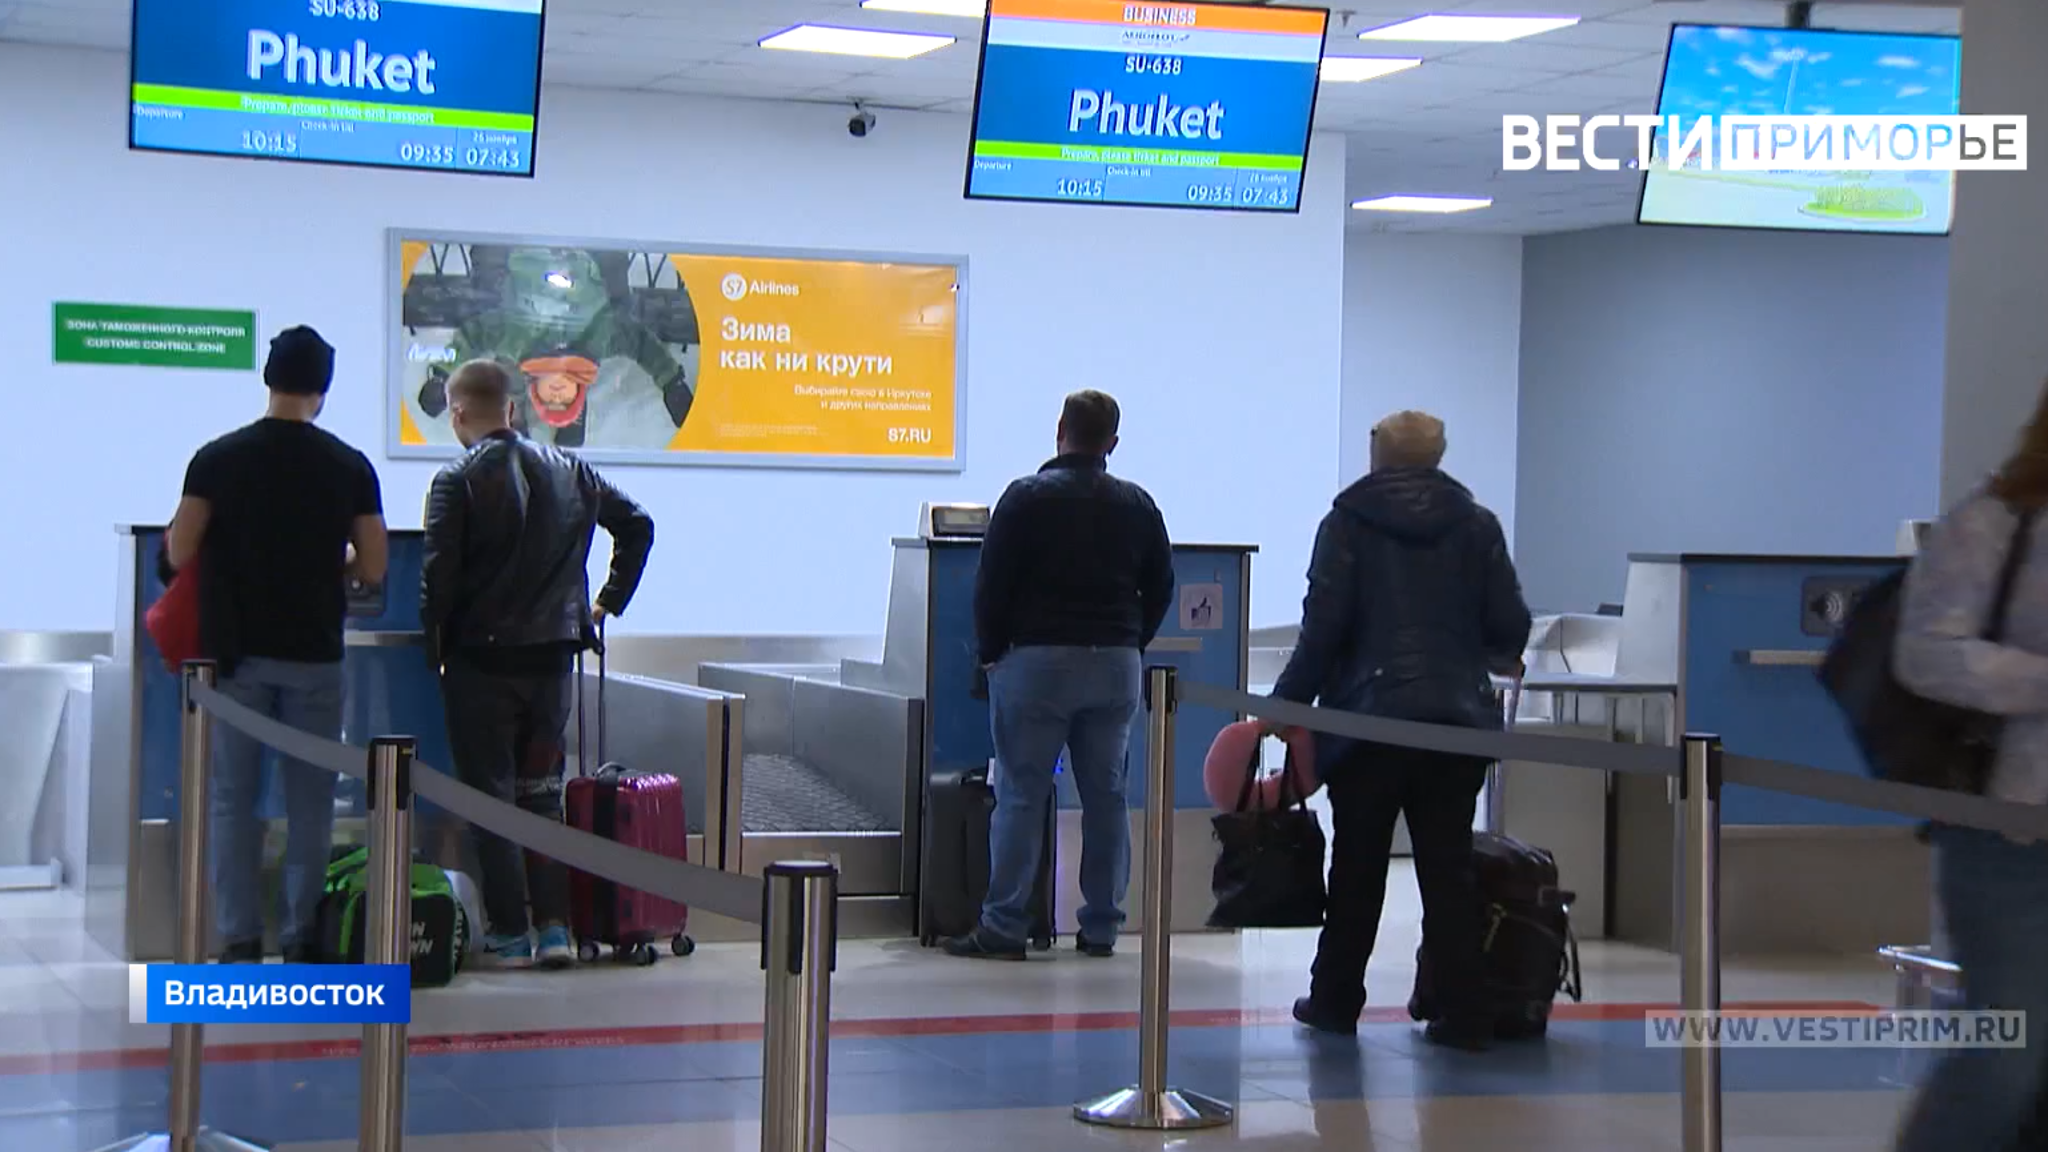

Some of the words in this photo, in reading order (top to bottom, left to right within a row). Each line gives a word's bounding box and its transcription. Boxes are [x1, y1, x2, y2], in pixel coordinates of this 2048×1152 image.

[309, 0, 381, 21] SU-638
[1123, 6, 1197, 26] BUSINESS
[247, 29, 436, 95] Phuket
[1125, 55, 1182, 76] SU-638
[136, 105, 184, 120] Departure
[387, 110, 434, 126] passport
[1068, 88, 1225, 140] Phuket
[242, 130, 297, 153] 10:15
[400, 142, 454, 164] 09:35
[466, 147, 520, 168] 07:43
[1161, 150, 1179, 164] and
[1180, 154, 1219, 168] passport
[973, 159, 1012, 171] Departure
[1057, 178, 1102, 196] 10:15
[1187, 184, 1233, 202] 09:35
[1242, 186, 1289, 205] 07:43
[750, 280, 800, 296] Airlines
[66, 319, 99, 332] ЗОНА
[102, 321, 186, 336] ТАМОЖЕННОГО
[188, 325, 246, 338] КОНТРОЛЯ
[722, 316, 791, 343] Зима
[86, 337, 141, 350] CUSTOMS
[143, 339, 195, 352] CONTROL
[197, 341, 226, 354] ZONE
[721, 350, 766, 371] как
[776, 352, 808, 372] ни
[817, 353, 893, 379] крути
[821, 400, 828, 410] и
[829, 401, 862, 411] других
[888, 427, 932, 444] S7.RU
